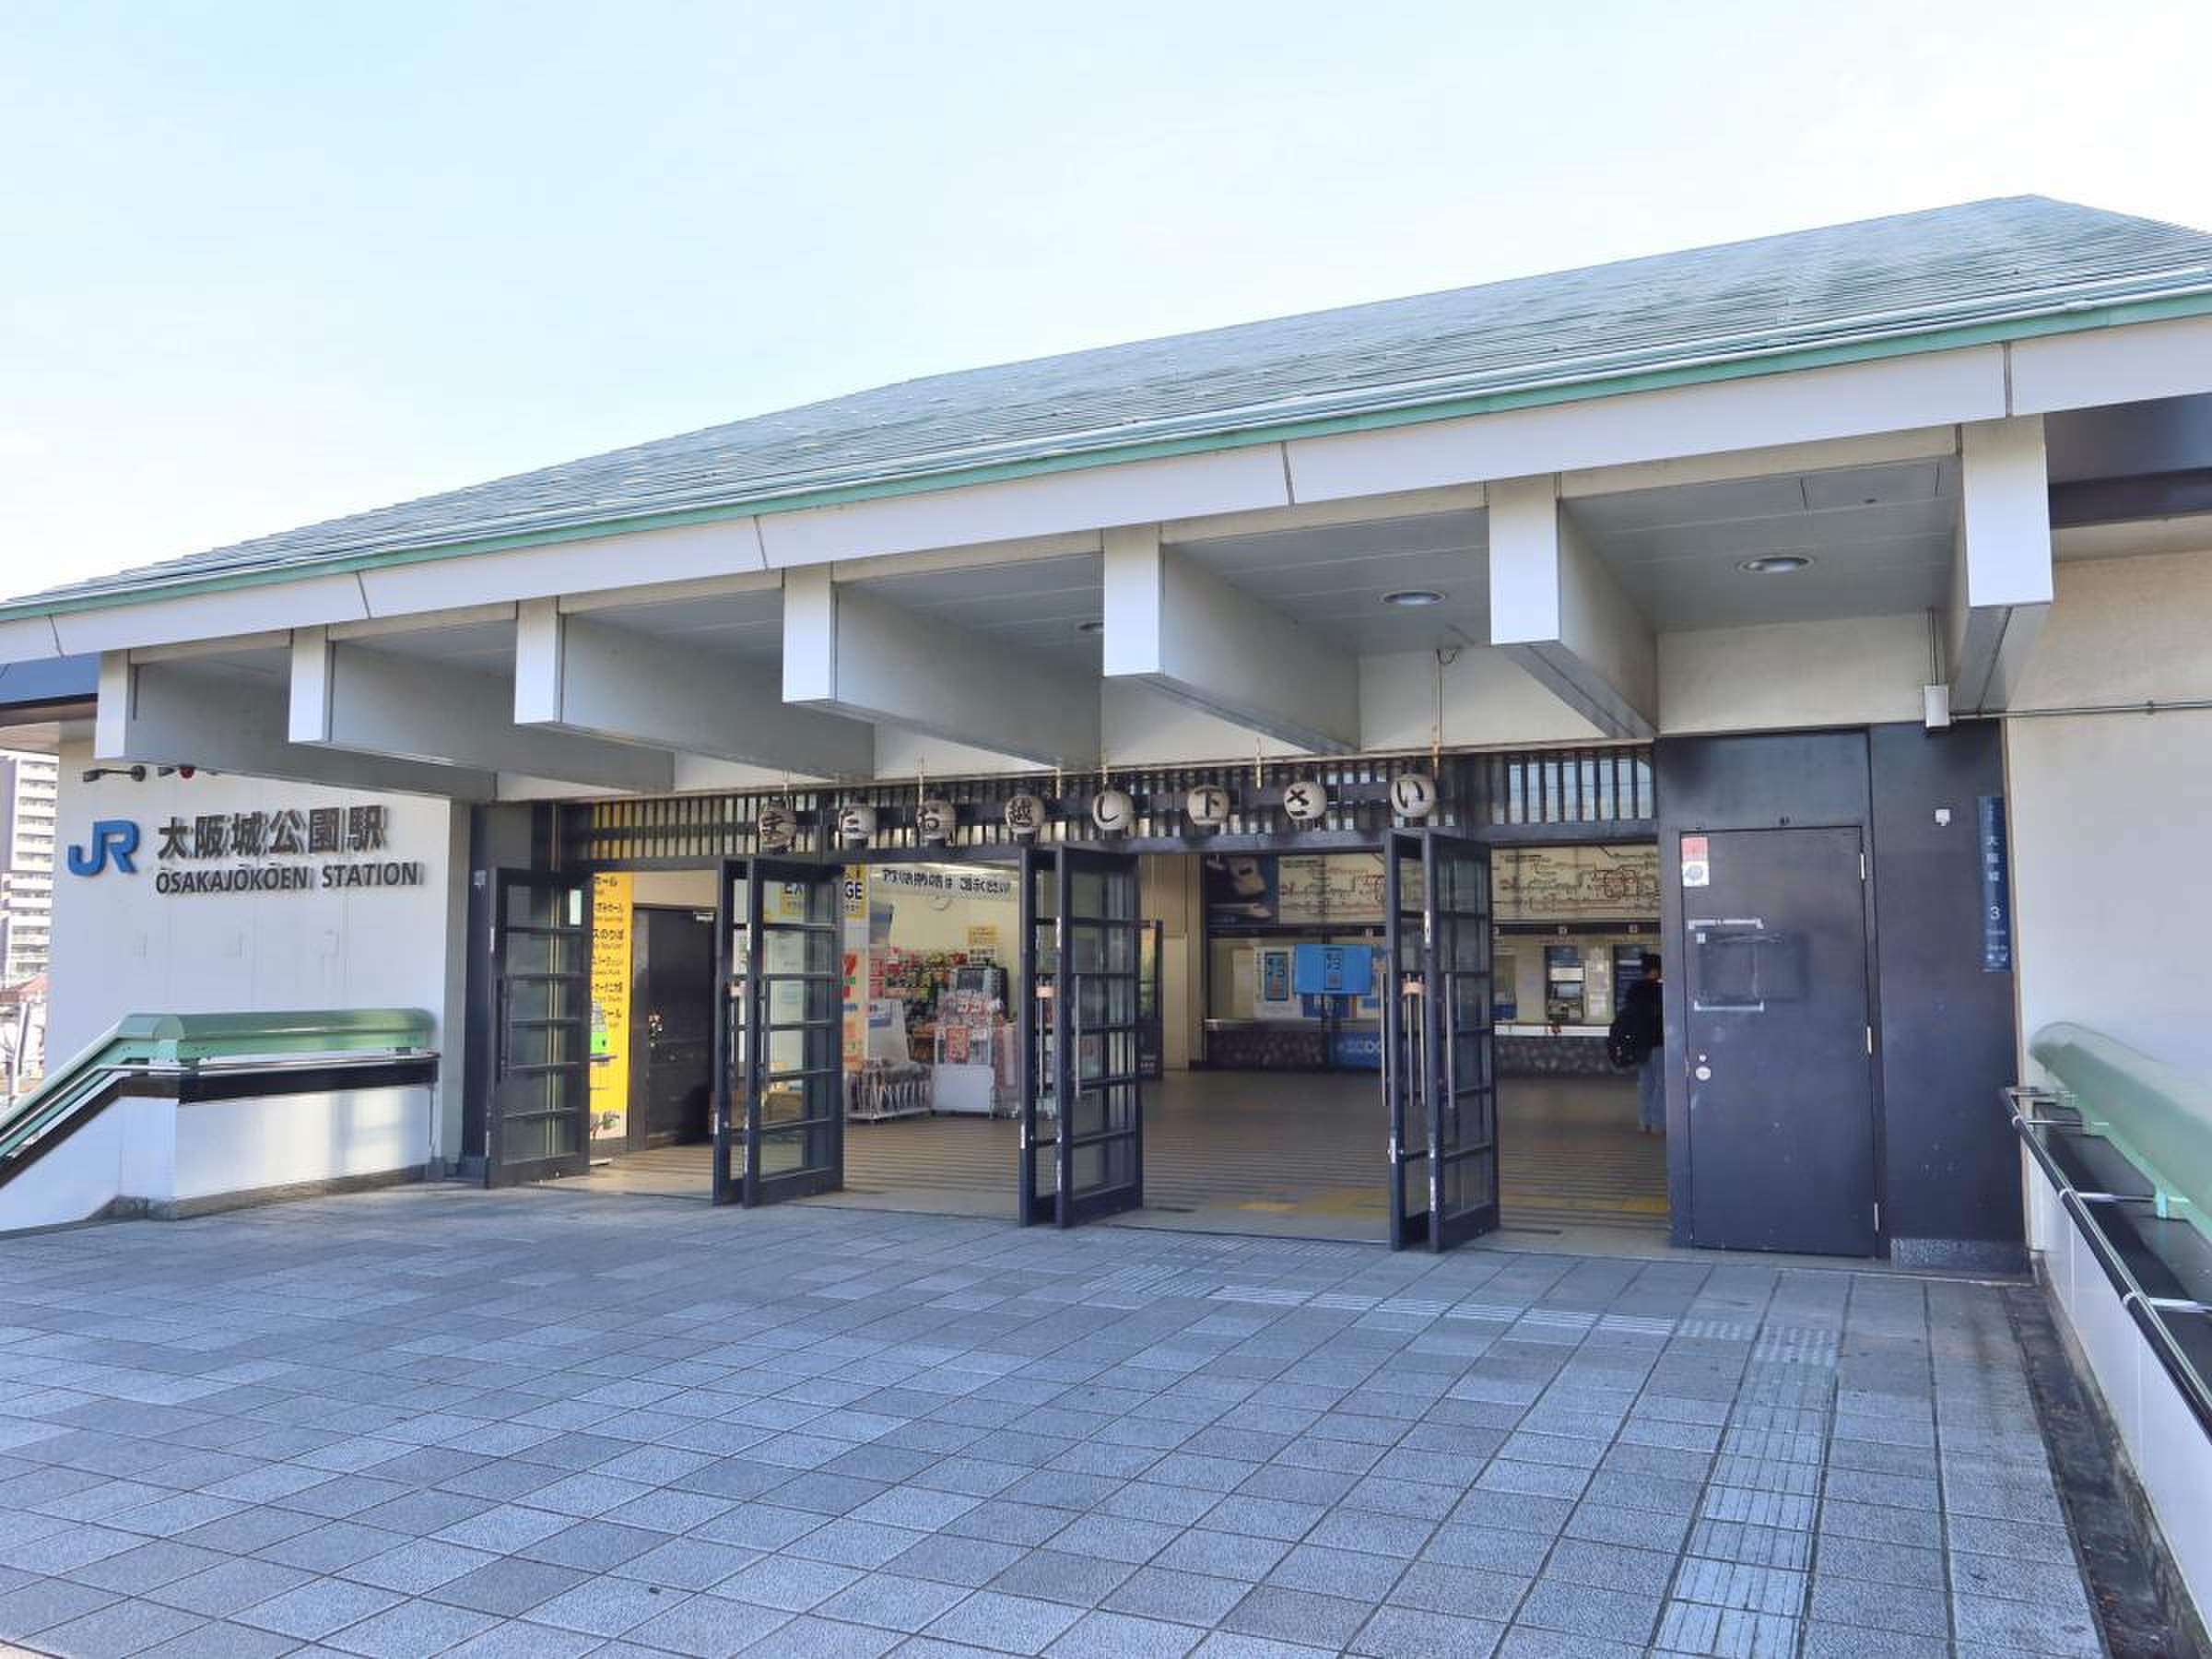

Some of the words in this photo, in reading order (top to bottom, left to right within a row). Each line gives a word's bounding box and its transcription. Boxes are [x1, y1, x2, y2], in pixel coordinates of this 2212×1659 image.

[67, 819, 139, 877] JR
[158, 805, 389, 861] 大阪城公園駅
[322, 862, 421, 888] STATION
